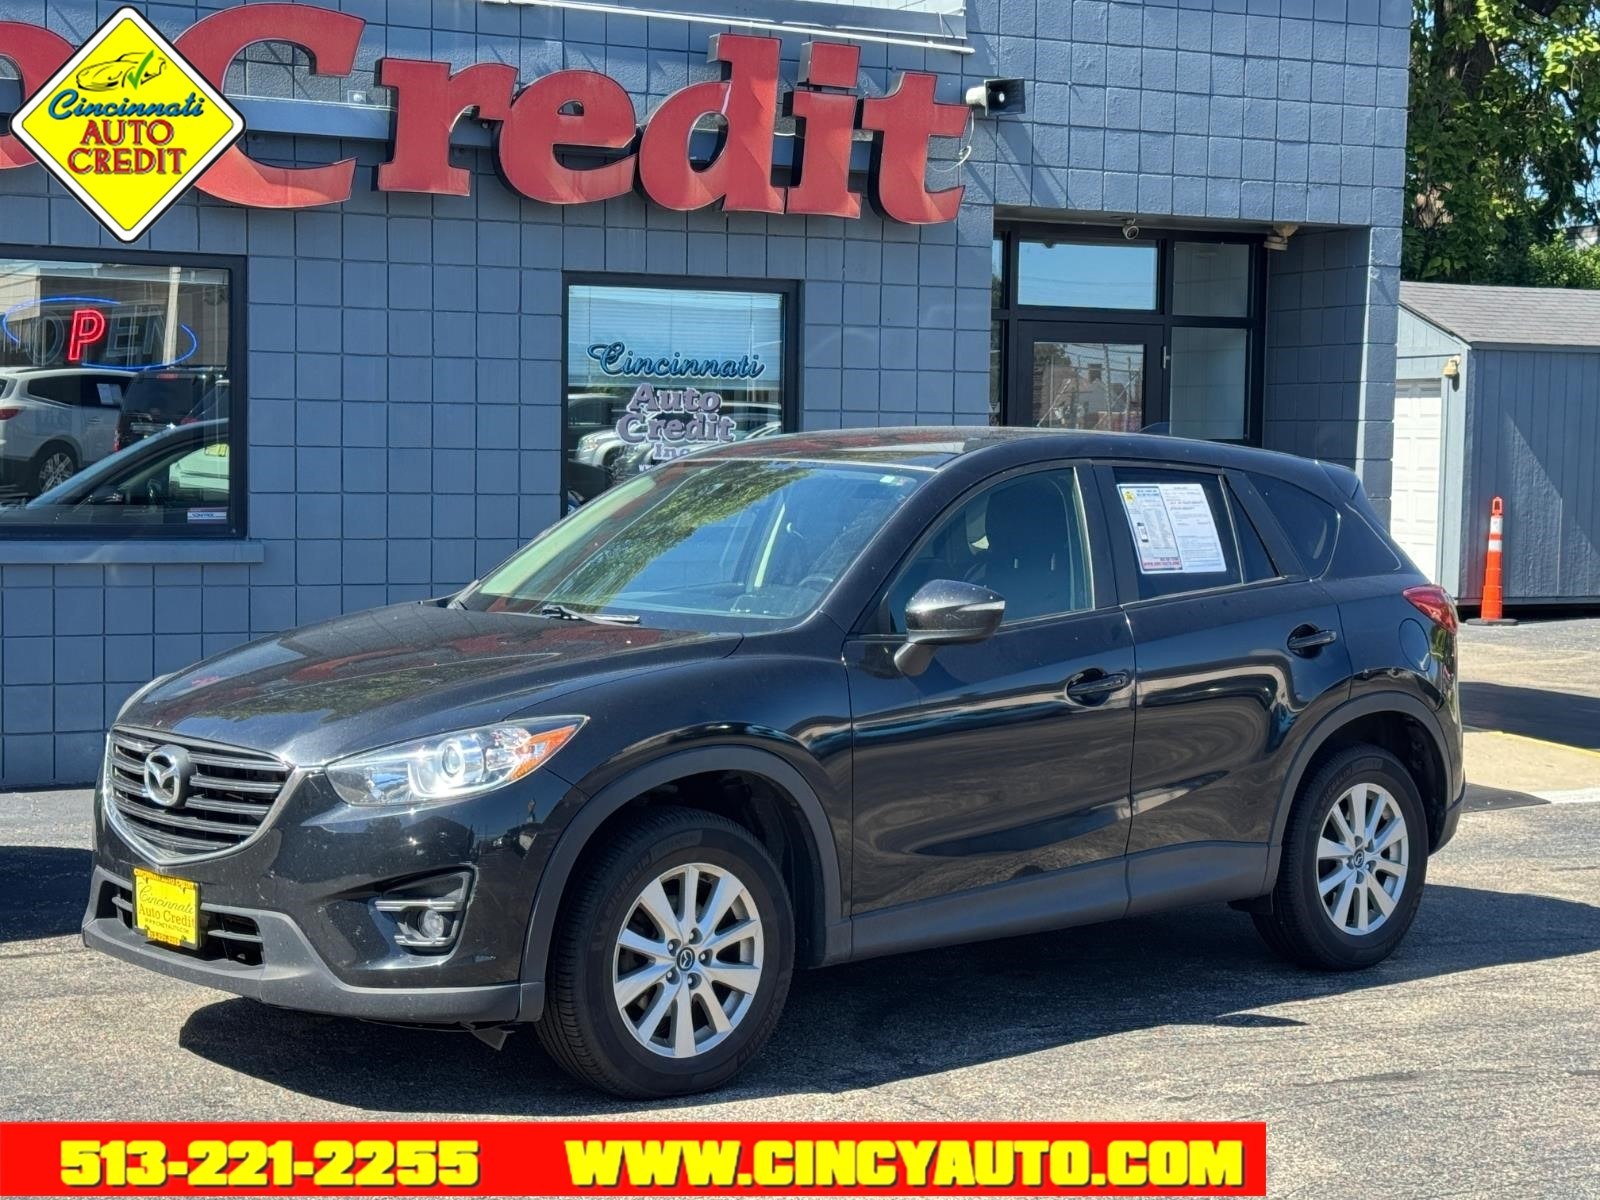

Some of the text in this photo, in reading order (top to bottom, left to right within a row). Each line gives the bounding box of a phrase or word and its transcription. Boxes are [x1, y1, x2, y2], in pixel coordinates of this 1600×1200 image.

[174, 2, 969, 225] Credit
[587, 341, 766, 379] Cincinnati
[625, 382, 722, 414] Auto
[615, 412, 737, 445] Credit
[138, 903, 196, 929] Auto Credit
